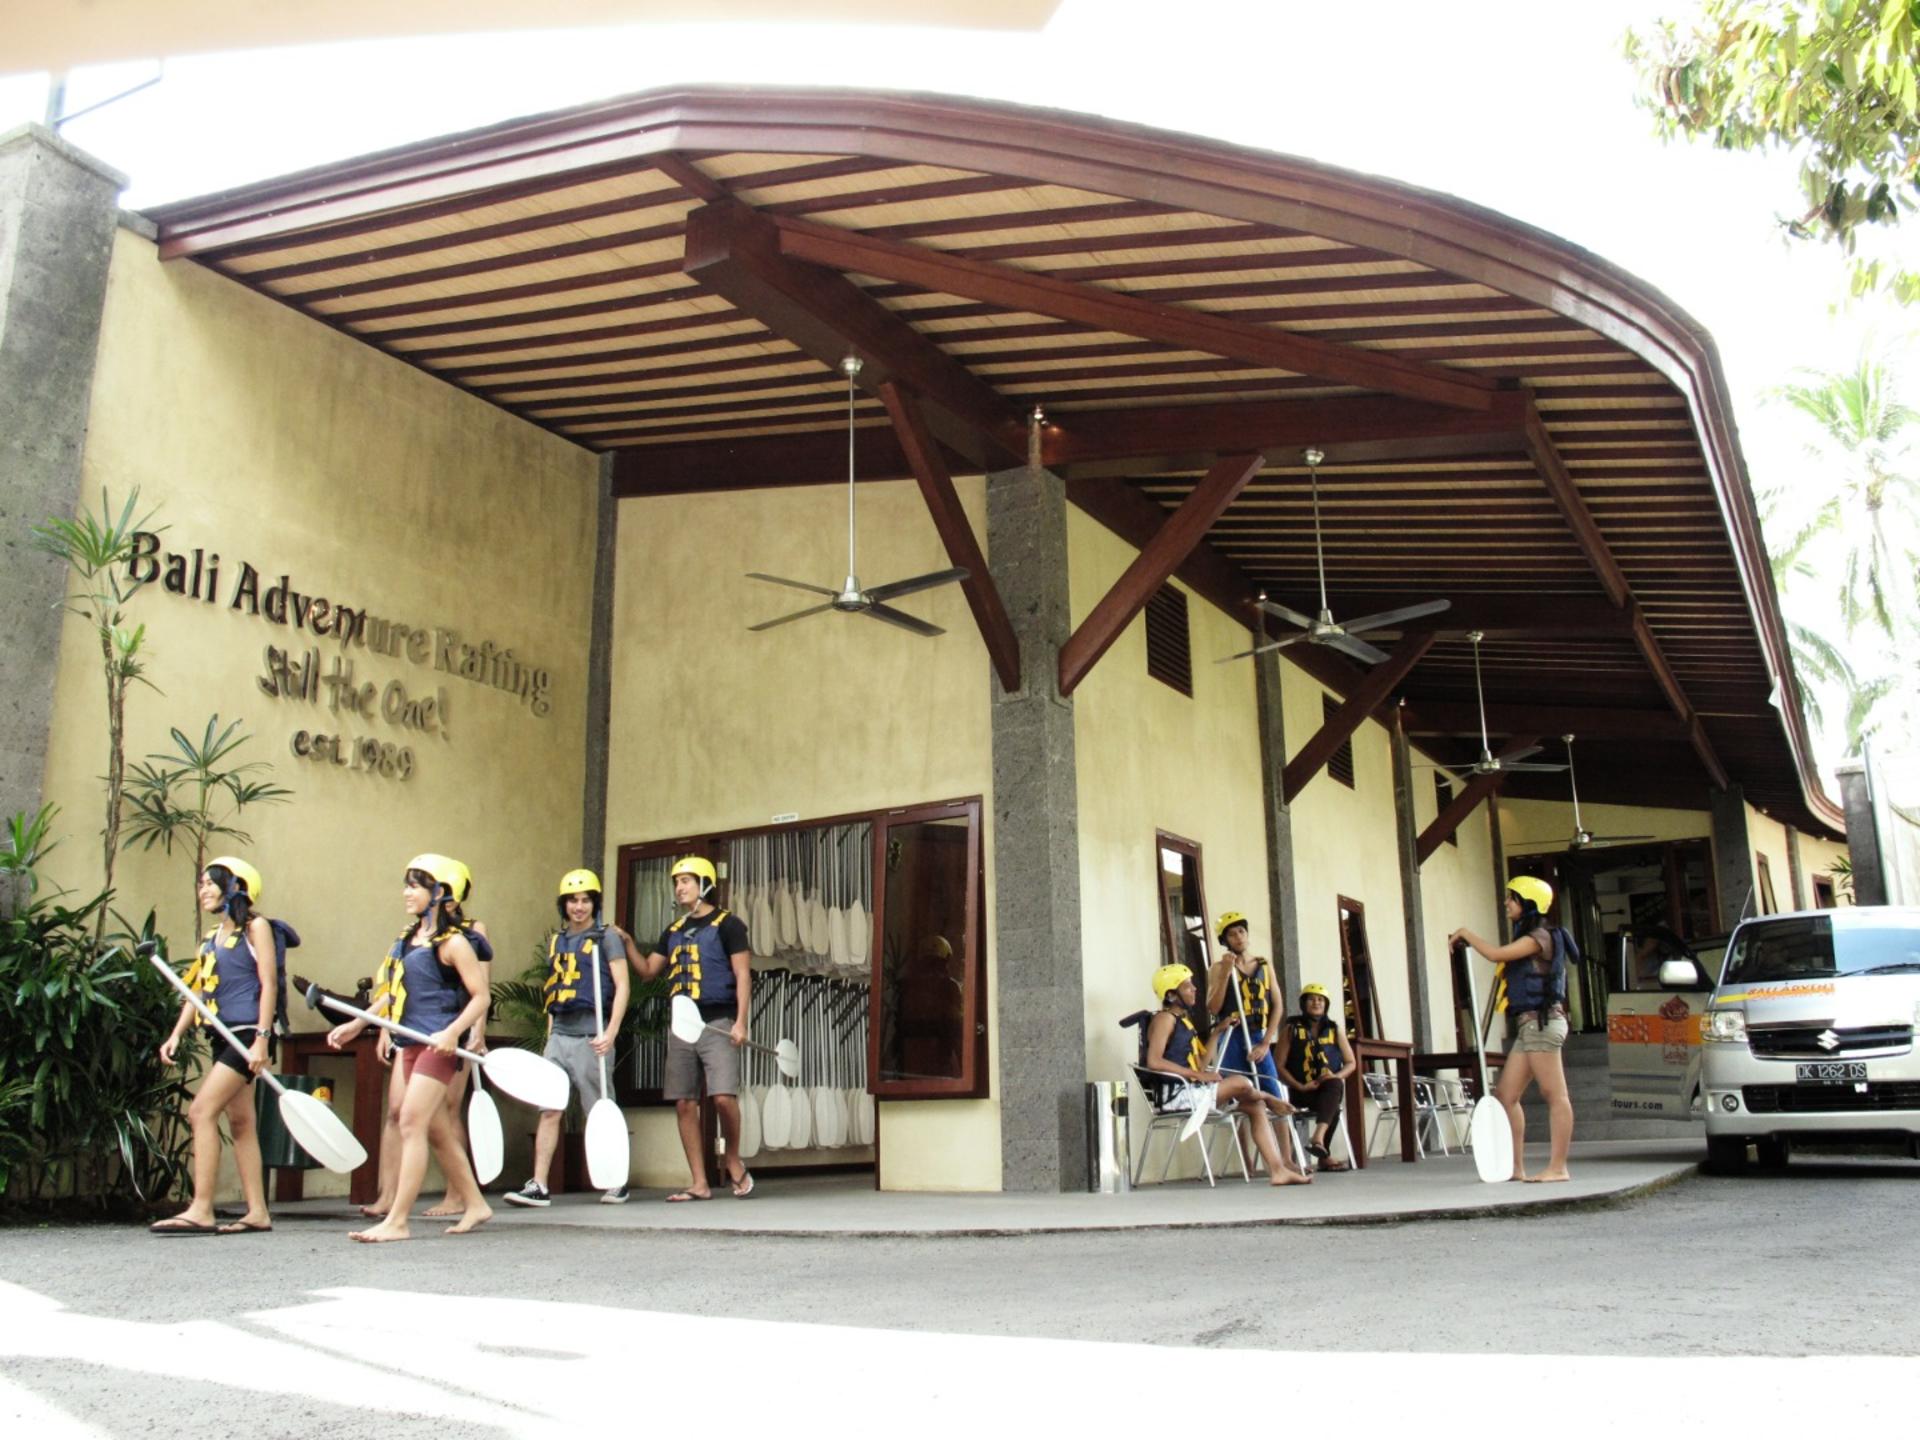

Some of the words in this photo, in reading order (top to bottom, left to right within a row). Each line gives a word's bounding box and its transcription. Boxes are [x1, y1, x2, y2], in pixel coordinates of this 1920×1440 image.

[125, 531, 220, 603] Bali
[229, 560, 430, 665] Adventure
[433, 627, 552, 719] Rafting
[256, 644, 320, 704] Still
[381, 679, 450, 742] One!
[349, 734, 416, 782] 1989
[1797, 1064, 1813, 1079] DK
[1817, 1064, 1846, 1079] 1262
[1849, 1062, 1866, 1079] DS
